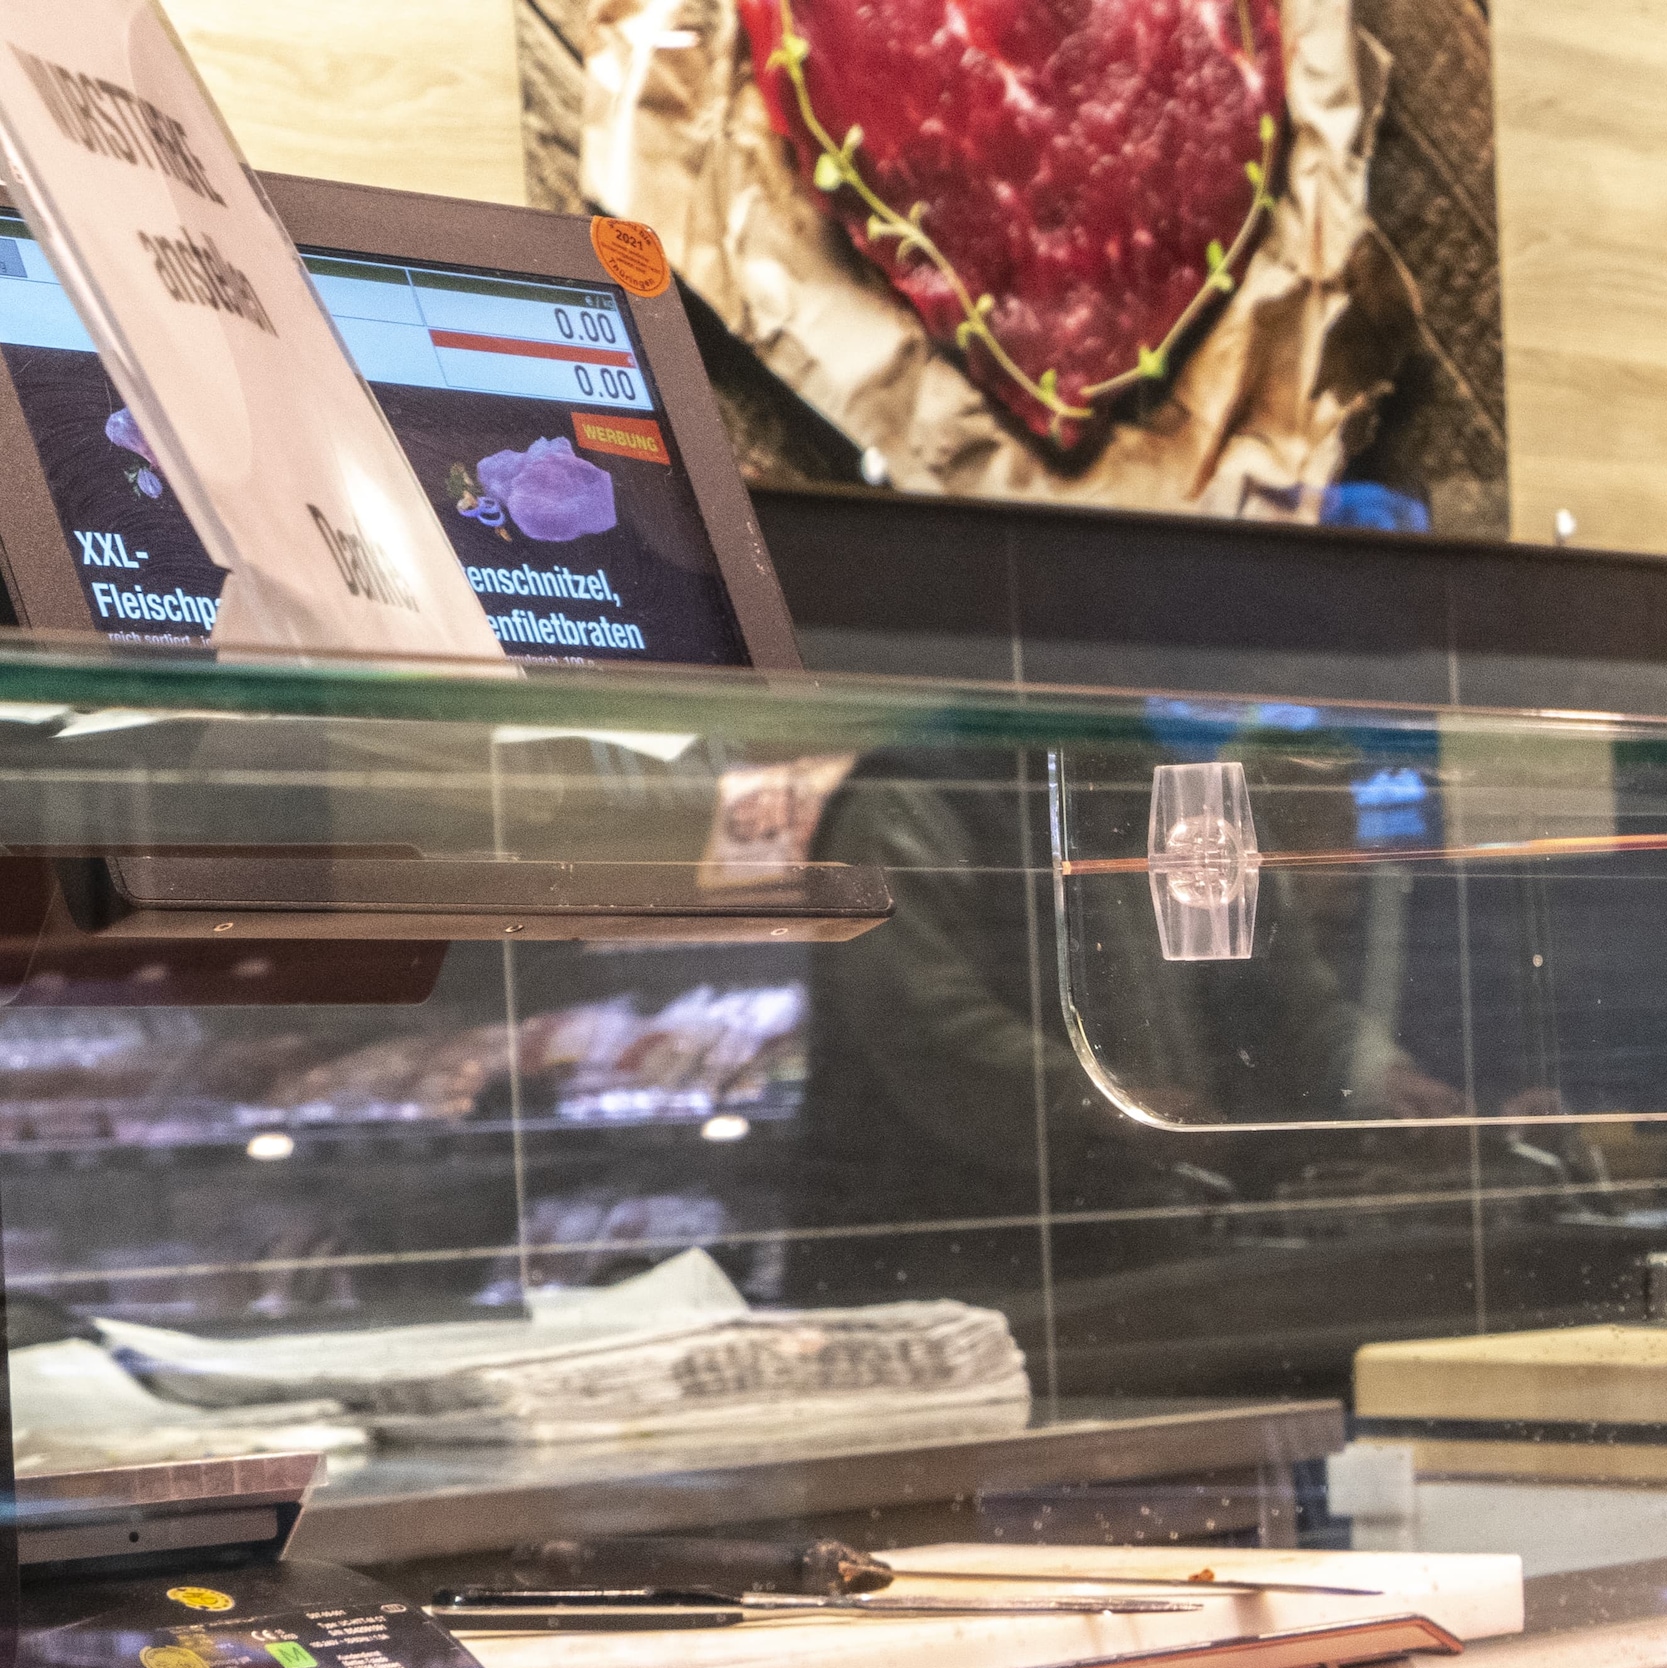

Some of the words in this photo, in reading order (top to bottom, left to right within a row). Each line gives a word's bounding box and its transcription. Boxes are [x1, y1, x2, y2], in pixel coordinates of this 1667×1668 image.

[615, 228, 643, 251] 2021
[554, 307, 617, 345] 0.00
[573, 364, 637, 401] 0.00
[581, 422, 660, 453] WERBUNG
[74, 530, 149, 569] XXL-
